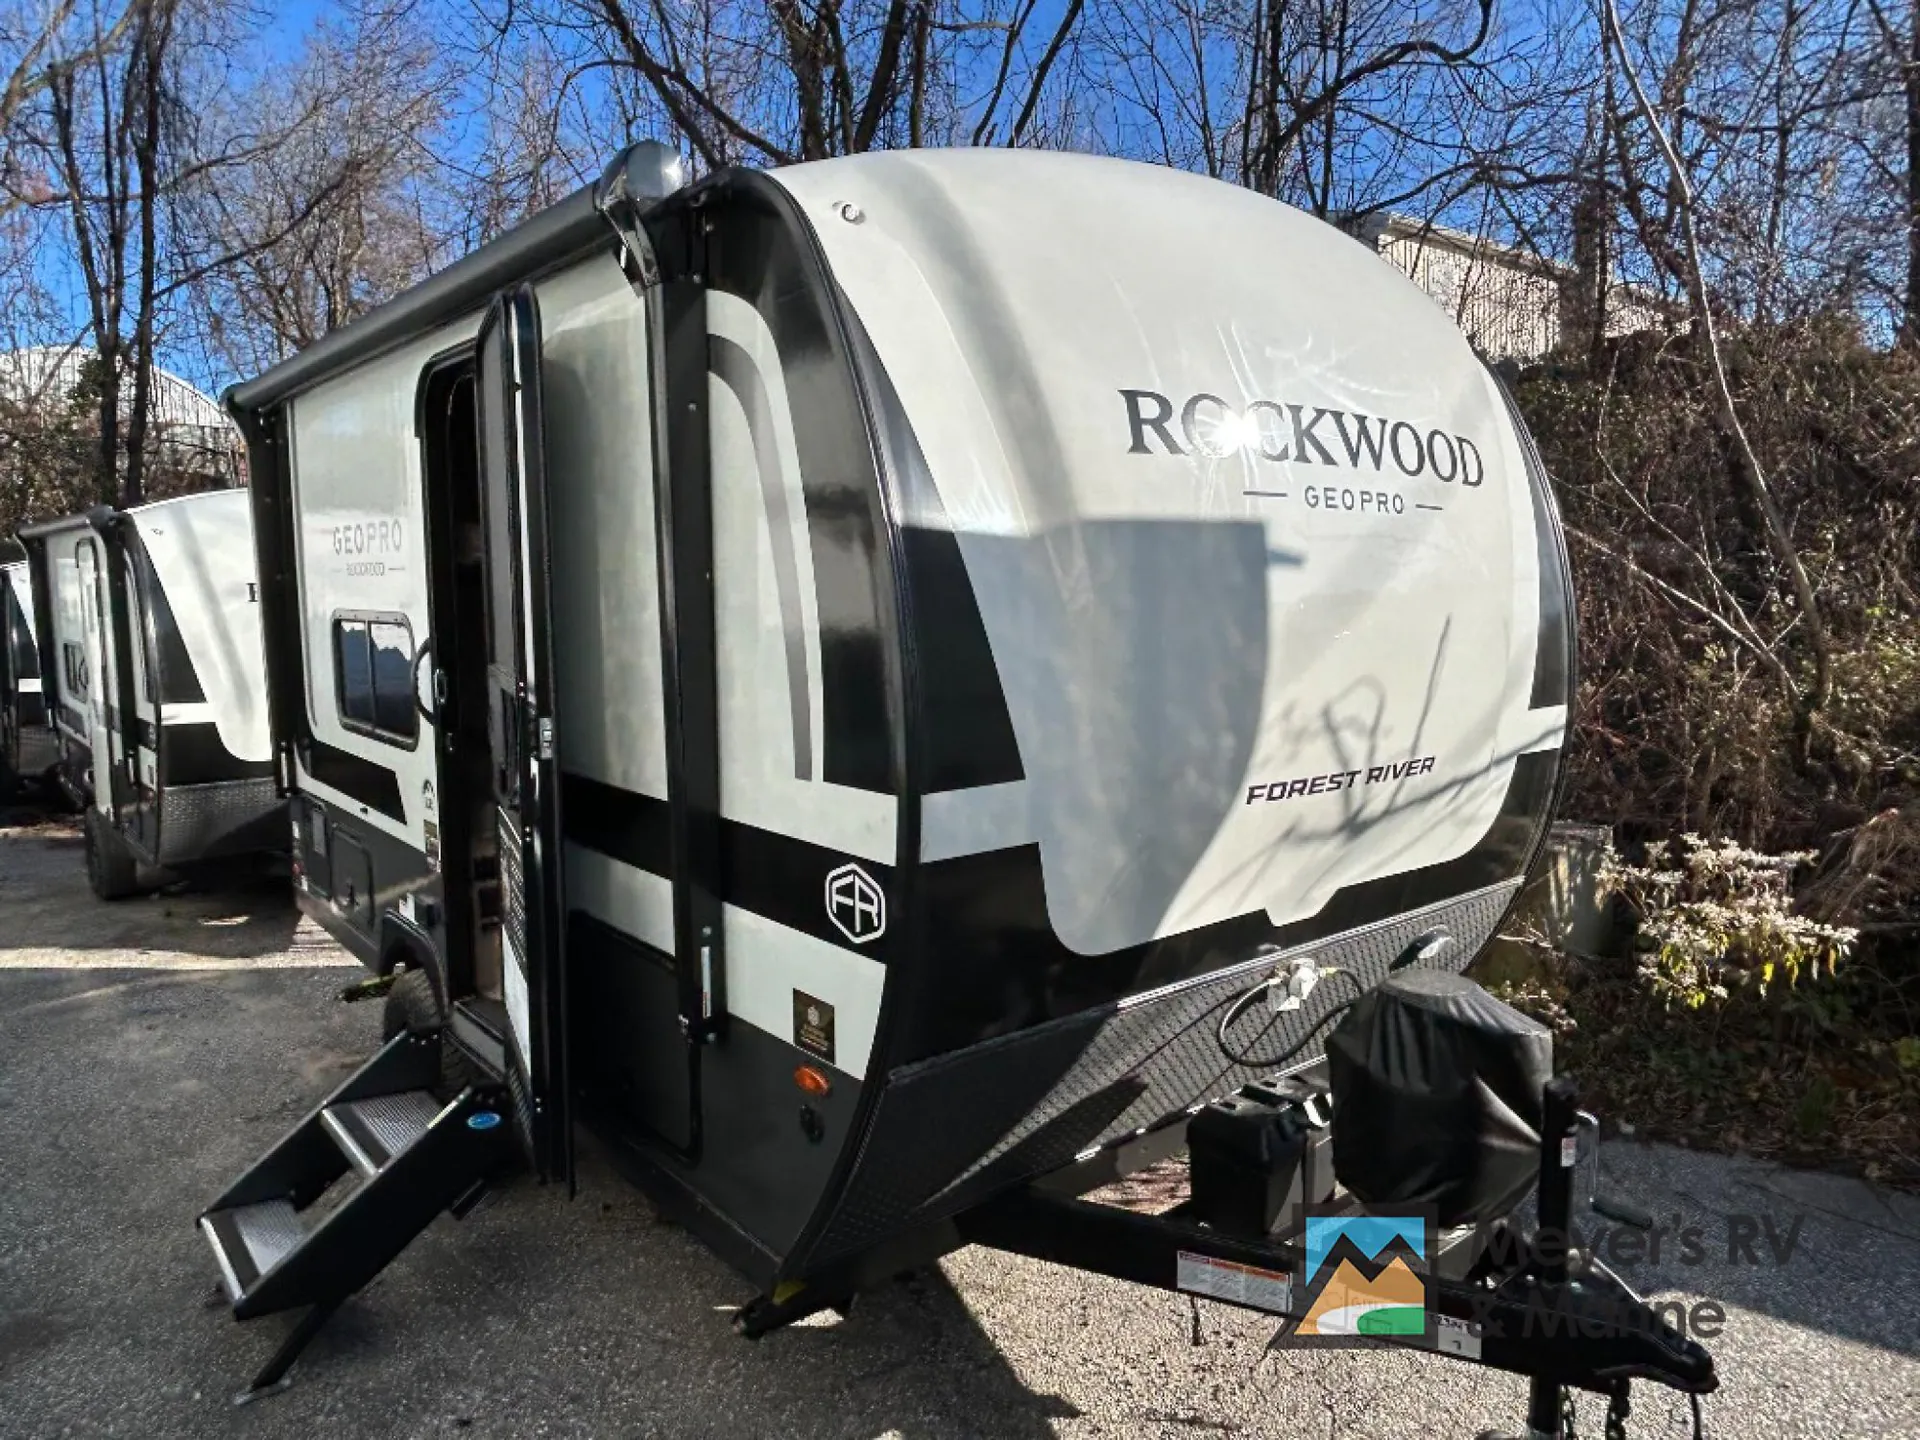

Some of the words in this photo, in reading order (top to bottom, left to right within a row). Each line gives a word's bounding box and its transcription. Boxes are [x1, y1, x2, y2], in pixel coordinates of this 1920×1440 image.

[1117, 388, 1484, 487] ROCKWOOD
[1304, 484, 1405, 515] GEOPRO
[332, 517, 403, 556] GEOPRO
[1245, 769, 1362, 806] FOREST
[1364, 755, 1437, 785] RIVER
